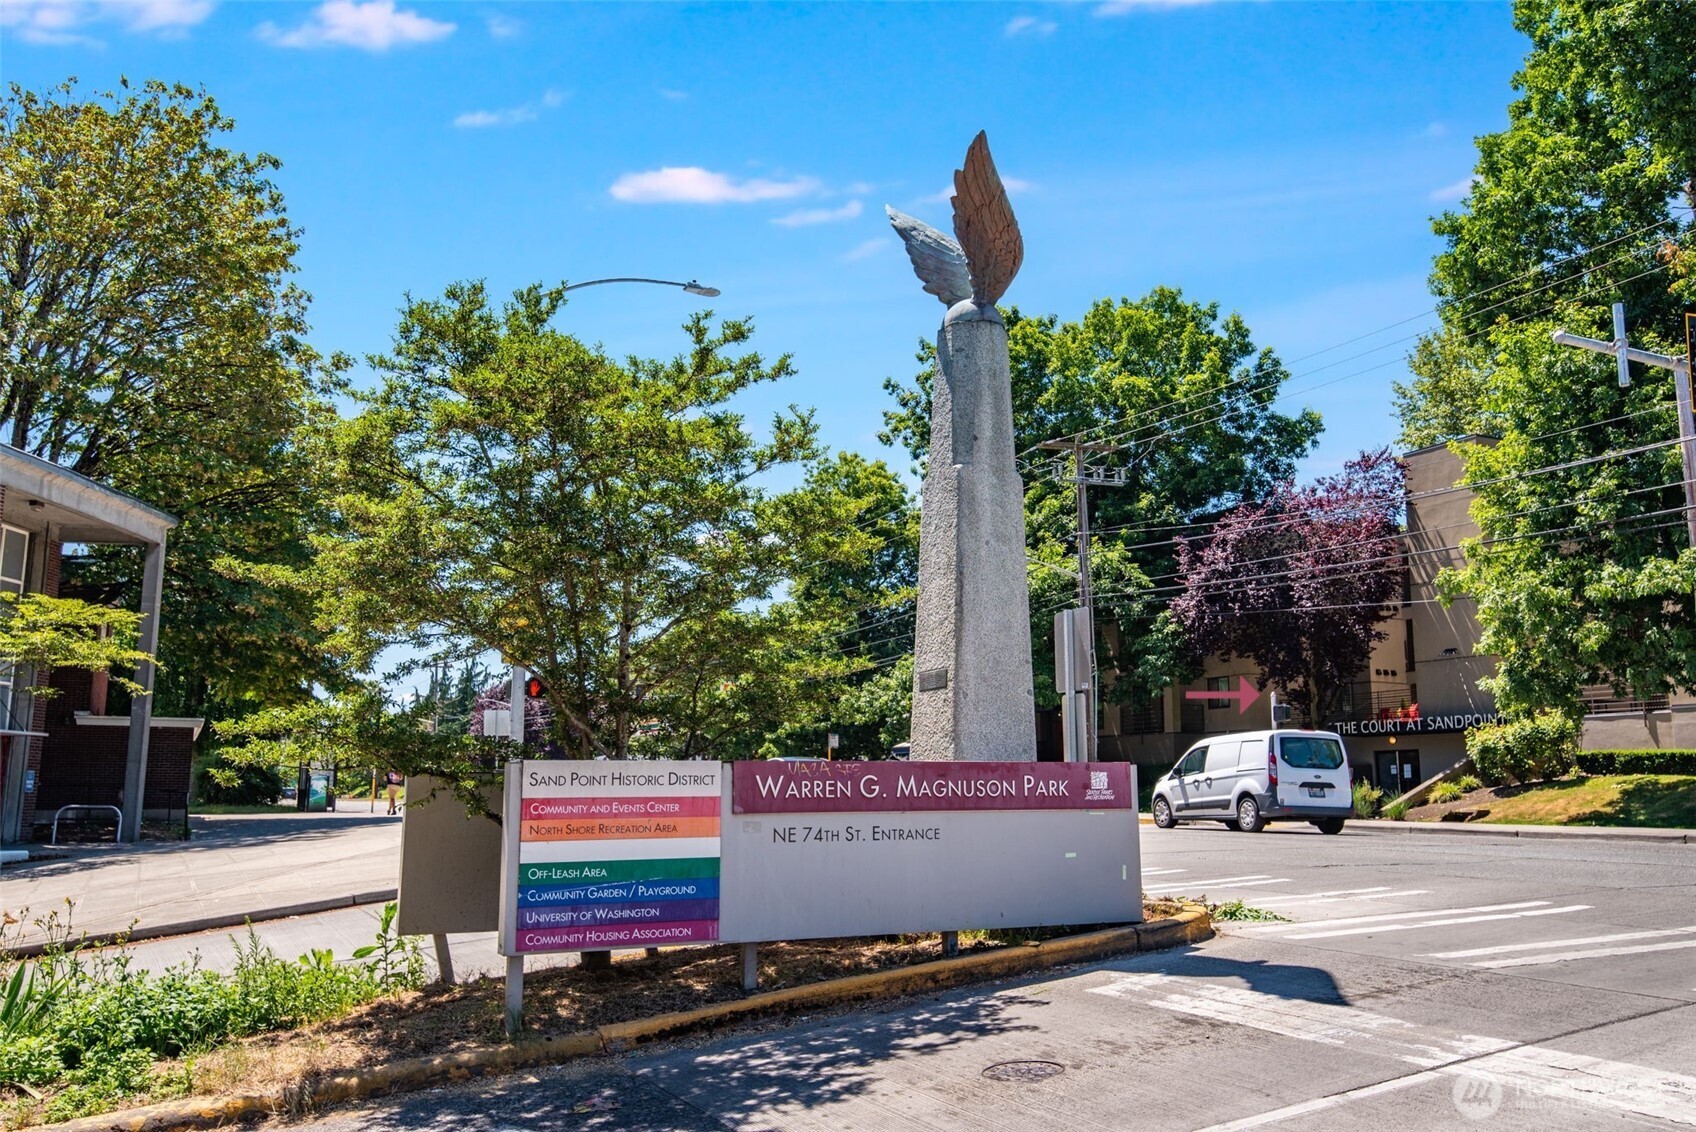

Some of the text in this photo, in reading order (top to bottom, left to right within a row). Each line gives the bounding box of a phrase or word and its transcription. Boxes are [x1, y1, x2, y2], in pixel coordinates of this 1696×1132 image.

[1335, 721, 1358, 734] THE
[1360, 719, 1401, 734] COURT
[1406, 717, 1424, 732] AT
[529, 772, 716, 787] SAND POINT HISTORIC DISTRICT
[756, 775, 852, 799] WARREN
[860, 774, 887, 798] G.
[897, 775, 1016, 798] MAGNUSON
[1023, 775, 1070, 798] PARK
[530, 802, 680, 814] COMMUNITY AND EVENTS CENTER
[529, 823, 678, 835] NORTH SHORE RECREATION AREA
[772, 825, 941, 843] NE 74TH ST. ENTRANCE
[528, 867, 607, 880] OFF-LEASH AREA
[527, 889, 585, 901] COMMUNITY
[587, 887, 627, 898] GARDEN
[639, 885, 696, 896] PLAYGROUND
[526, 908, 660, 923] UNIVERSITY OF WASHINGTON
[526, 928, 691, 945] COMMUNITY HOUSING ASSOCIATION
